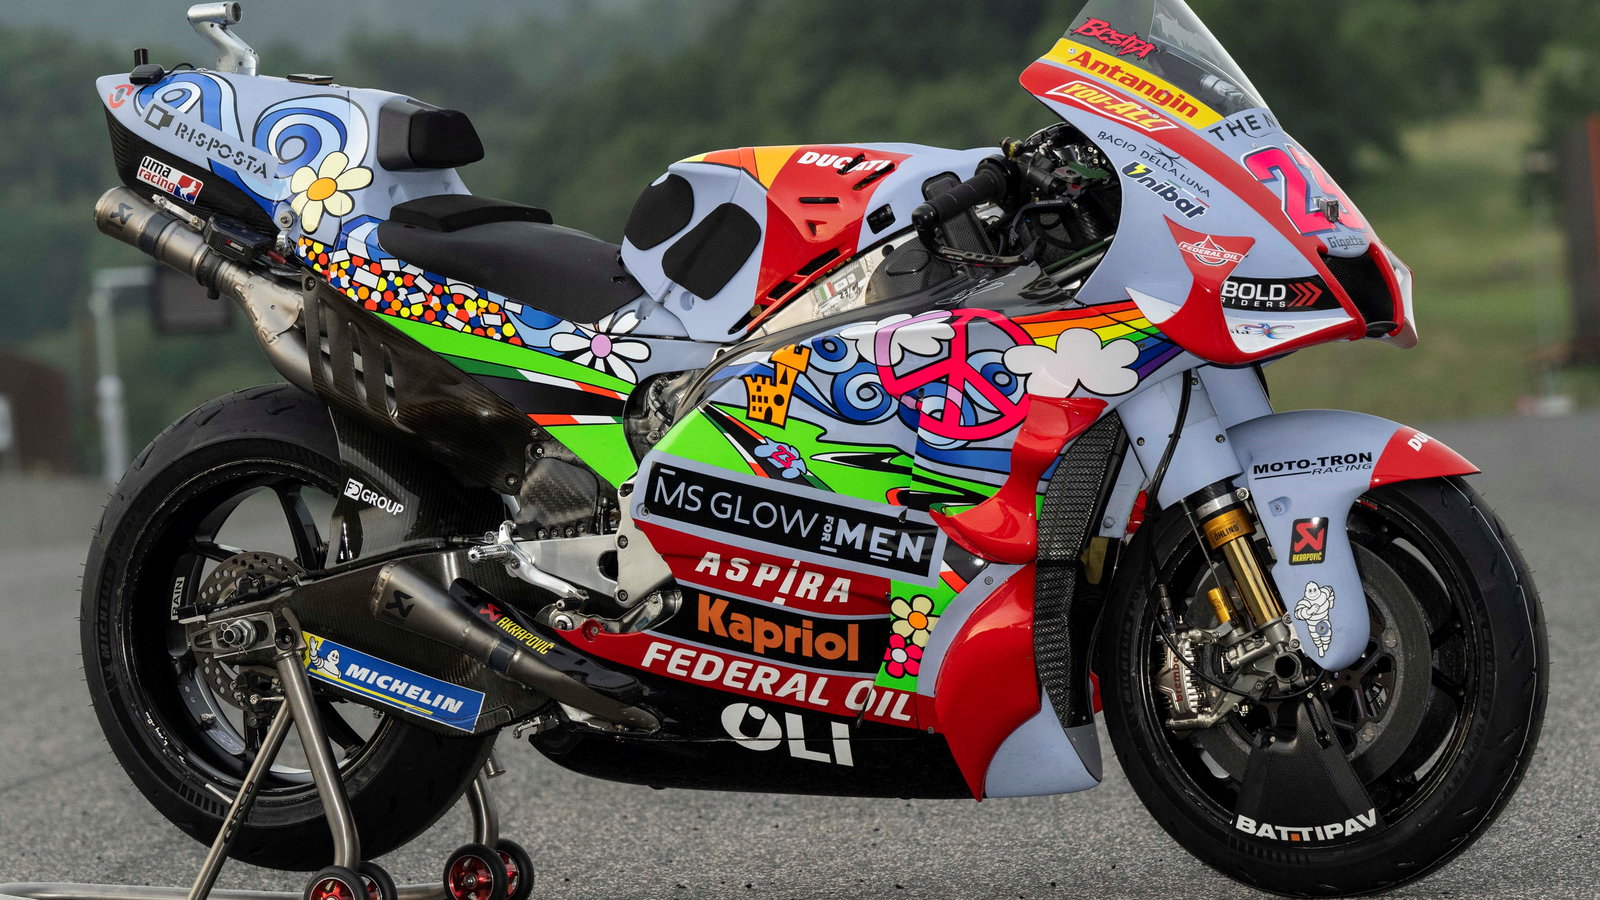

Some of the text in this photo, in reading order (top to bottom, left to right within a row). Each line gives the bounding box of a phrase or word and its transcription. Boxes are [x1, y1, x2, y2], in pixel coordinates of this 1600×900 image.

[1067, 50, 1199, 120] Antangin
[1208, 114, 1261, 141] THE
[141, 157, 172, 178] uma
[797, 151, 892, 172] DUCATI
[1097, 131, 1210, 198] BACIO DELLA LUNA
[138, 166, 175, 193] racing
[1121, 161, 1207, 219] Unibat
[1181, 243, 1239, 260] FEDERAL OIL
[1327, 235, 1366, 250] Gigetta
[1221, 280, 1287, 300] BOLD
[1221, 297, 1286, 308] RIDERS
[770, 445, 798, 470] 23
[1253, 452, 1373, 475] MOTO-TRON
[1311, 462, 1373, 476] RACING
[361, 488, 404, 516] GROUP
[654, 468, 926, 563] MS GLOW FOR MEN
[695, 551, 852, 606] ASPIRA
[697, 594, 859, 661] Kapriol
[344, 663, 464, 714] MICHELIN
[641, 641, 911, 721] FEDERAL OIL
[721, 702, 854, 767] OLI
[1235, 808, 1376, 842] BATTIPAV
